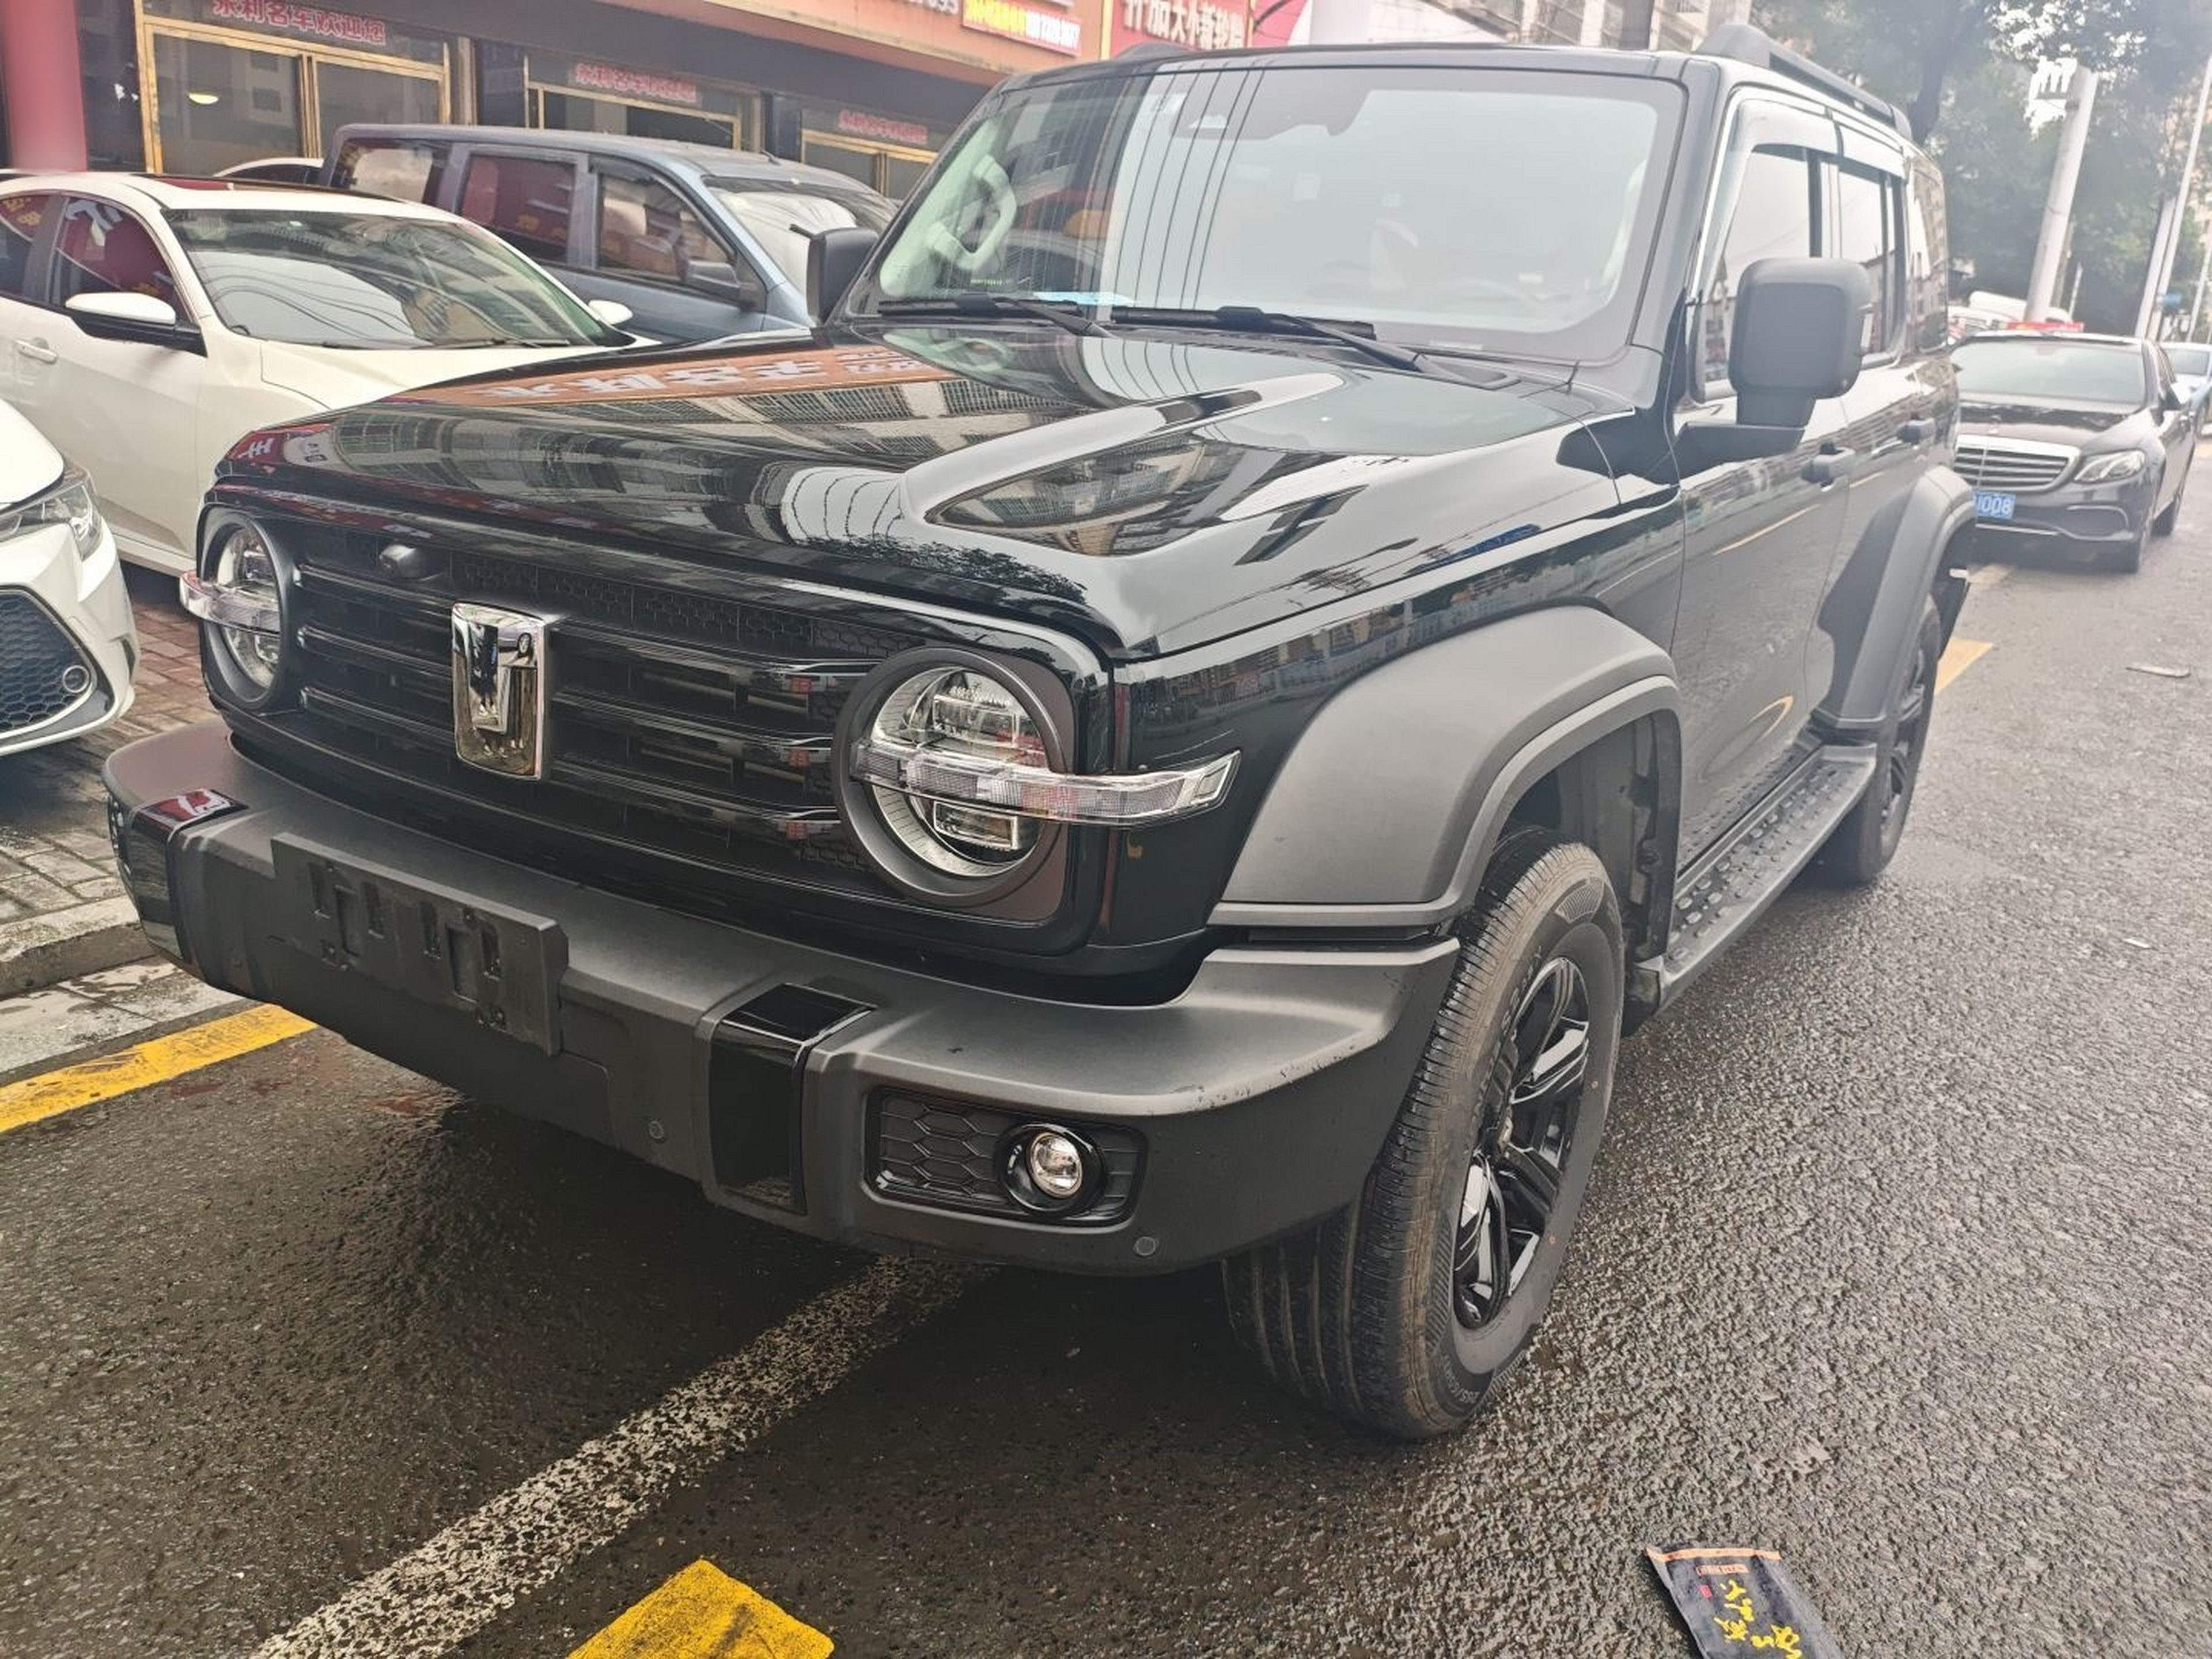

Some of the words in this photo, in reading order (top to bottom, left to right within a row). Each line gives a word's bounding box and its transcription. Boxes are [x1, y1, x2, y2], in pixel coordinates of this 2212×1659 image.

[213, 0, 386, 46] 永利名车欢迎您
